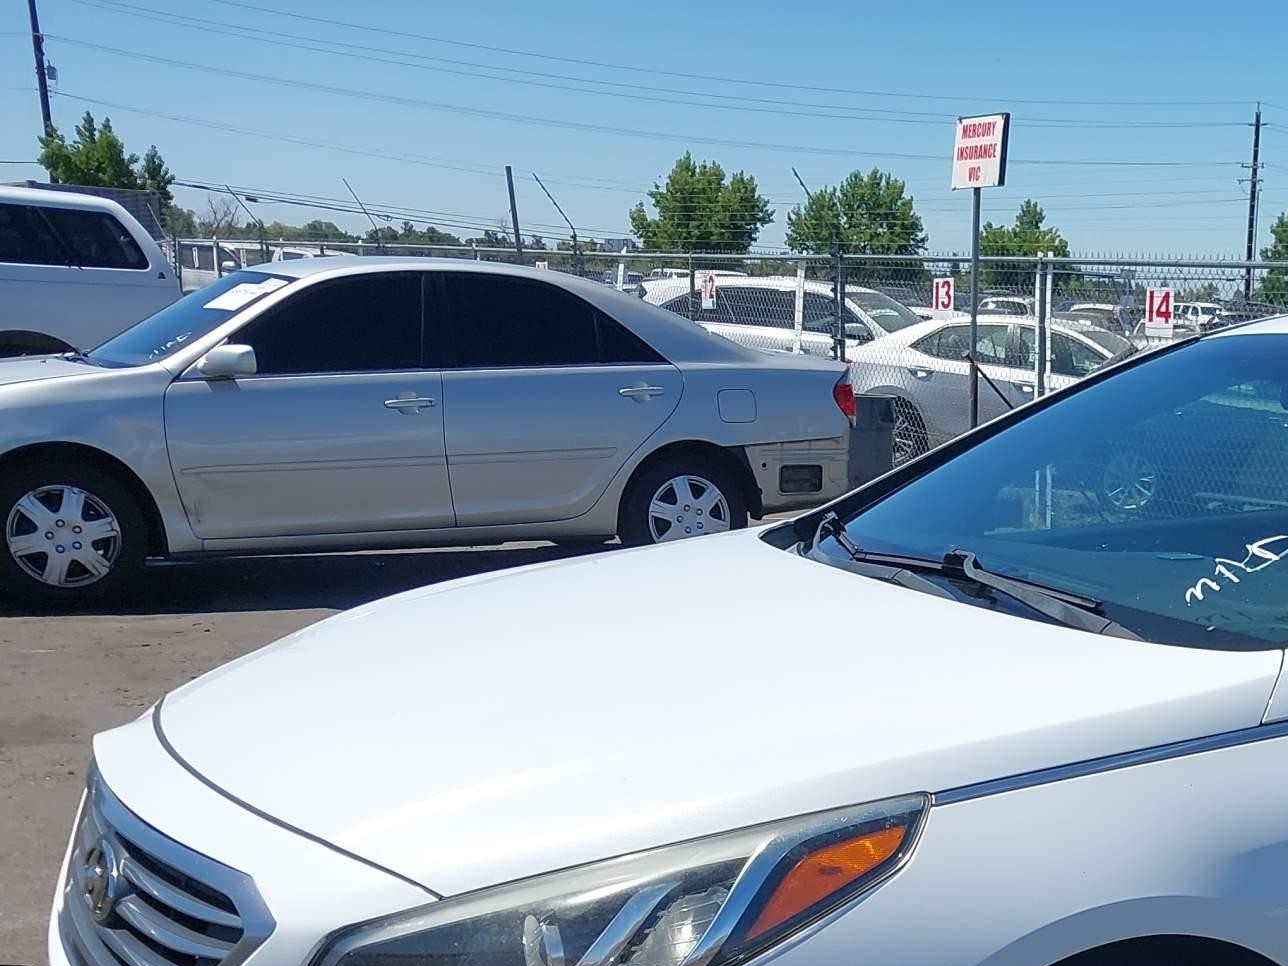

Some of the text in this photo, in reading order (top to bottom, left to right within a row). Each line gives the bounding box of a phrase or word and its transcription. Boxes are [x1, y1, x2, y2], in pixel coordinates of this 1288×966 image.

[961, 121, 997, 140] MERCURY
[957, 143, 998, 161] INSURANCE
[968, 166, 981, 182] VIC
[935, 280, 952, 310] 13
[1148, 290, 1172, 324] 14
